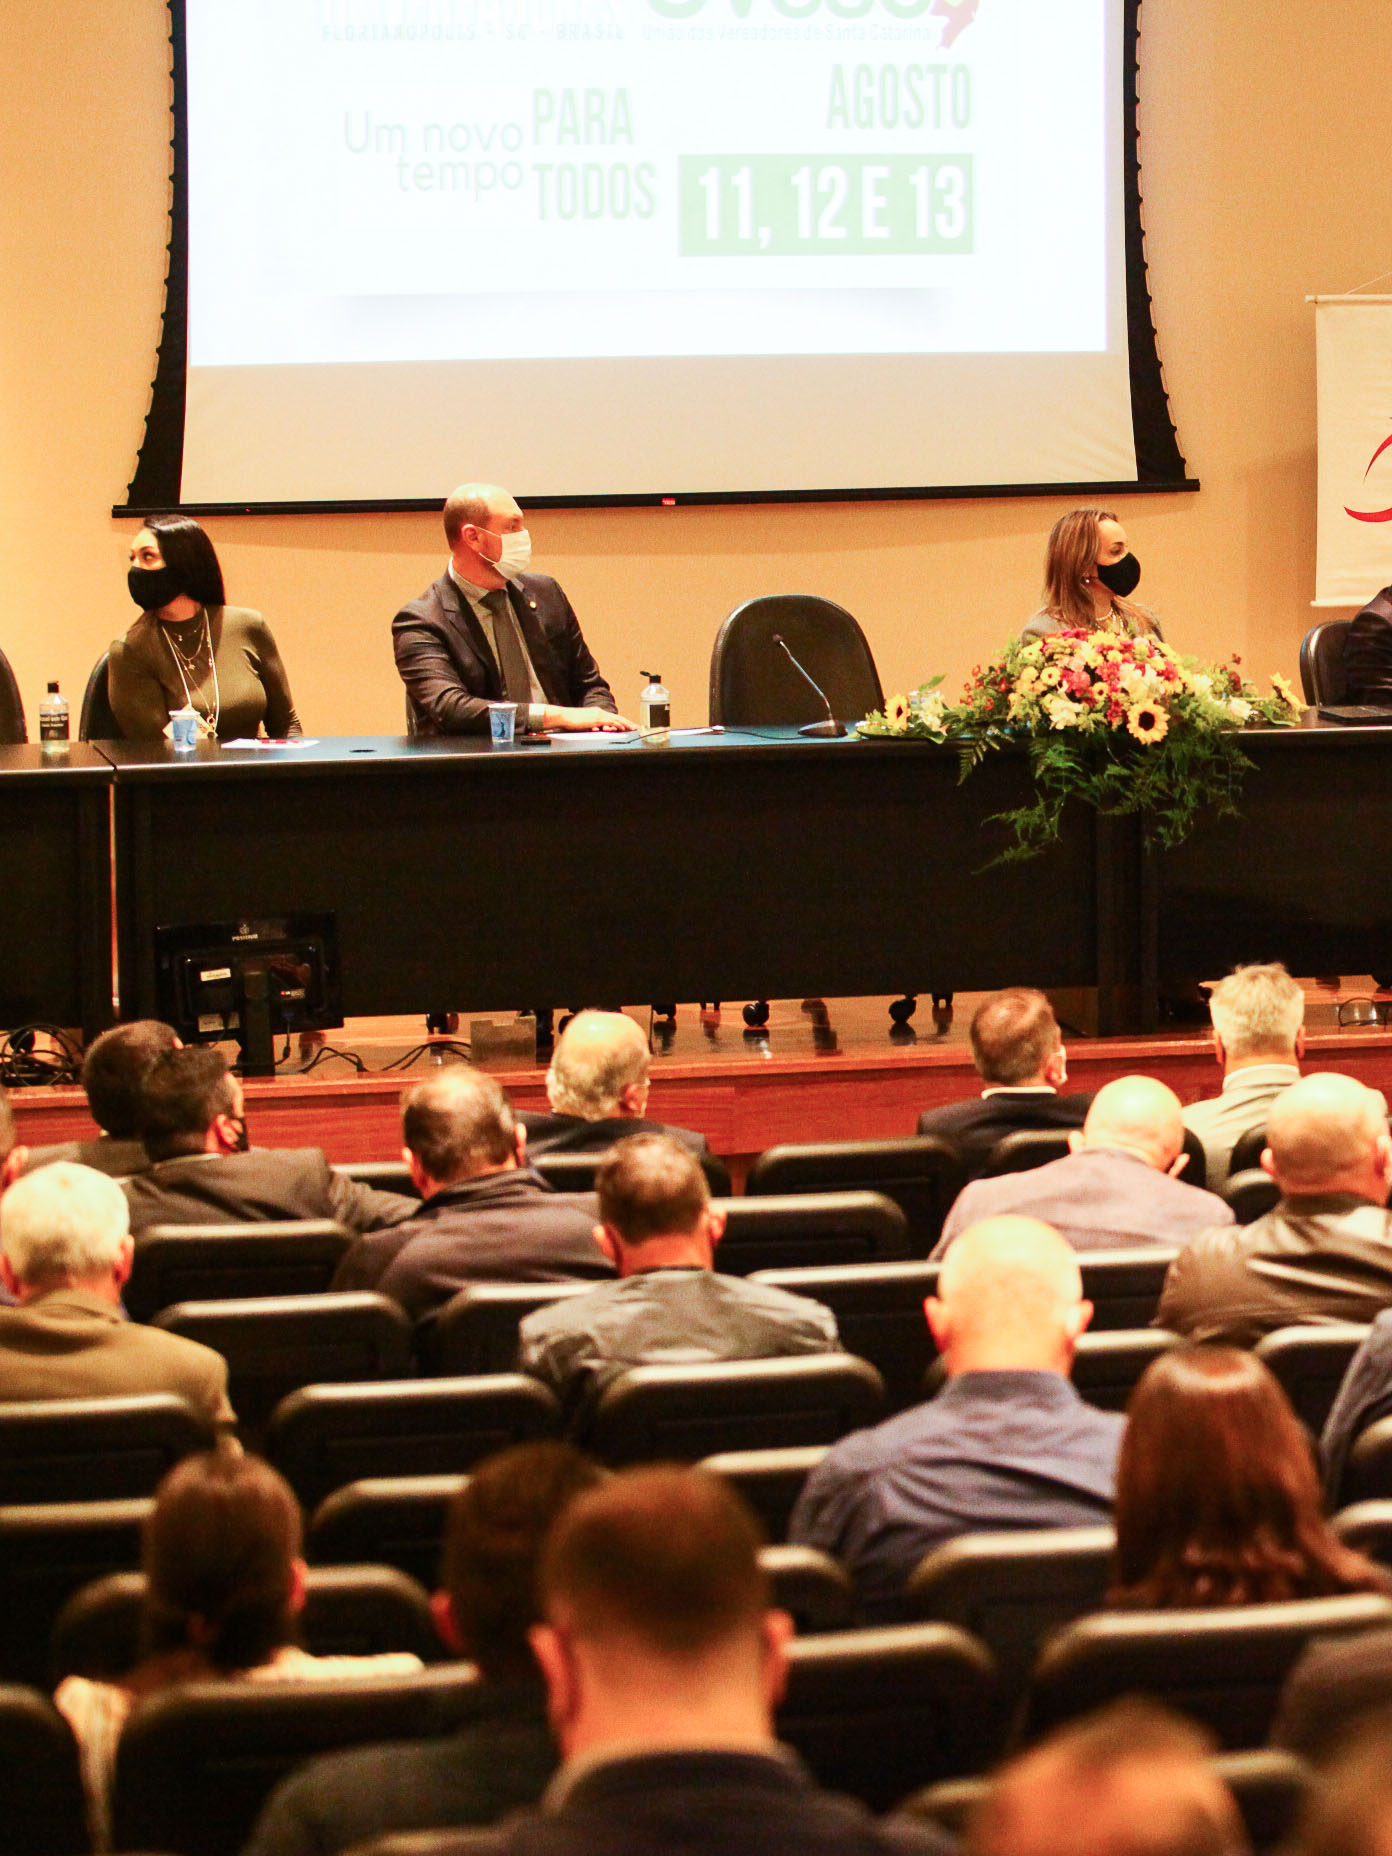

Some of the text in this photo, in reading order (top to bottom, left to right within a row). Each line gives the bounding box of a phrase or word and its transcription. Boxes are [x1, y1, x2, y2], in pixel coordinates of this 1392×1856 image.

[342, 87, 635, 154] Um novo PARA
[825, 63, 972, 130] AGOSTO
[395, 155, 657, 221] tempo TODOS
[698, 164, 966, 249] 11, 12 E 13
